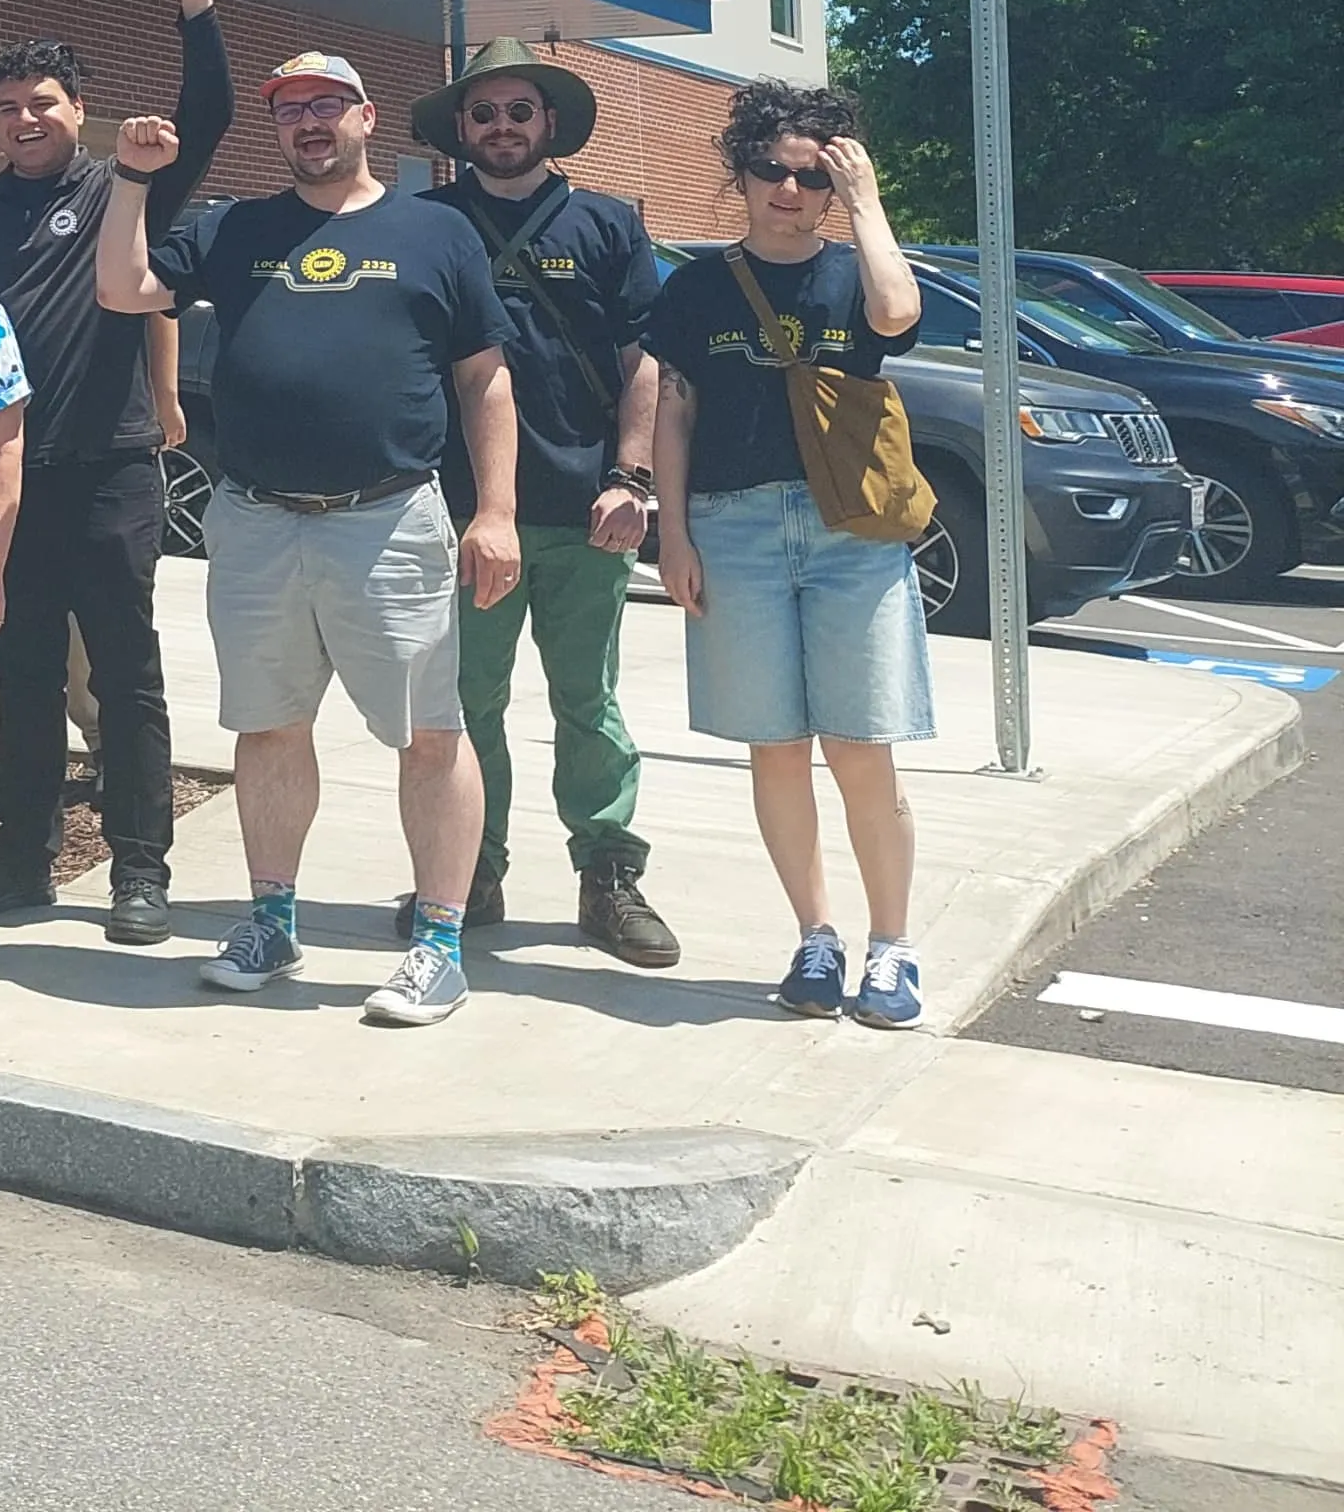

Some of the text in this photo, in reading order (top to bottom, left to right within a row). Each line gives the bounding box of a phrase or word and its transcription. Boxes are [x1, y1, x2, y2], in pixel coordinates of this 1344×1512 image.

[253, 260, 291, 270] LOCAL
[361, 260, 397, 271] 2322
[541, 258, 574, 269] 2322
[709, 331, 747, 345] LOCAL
